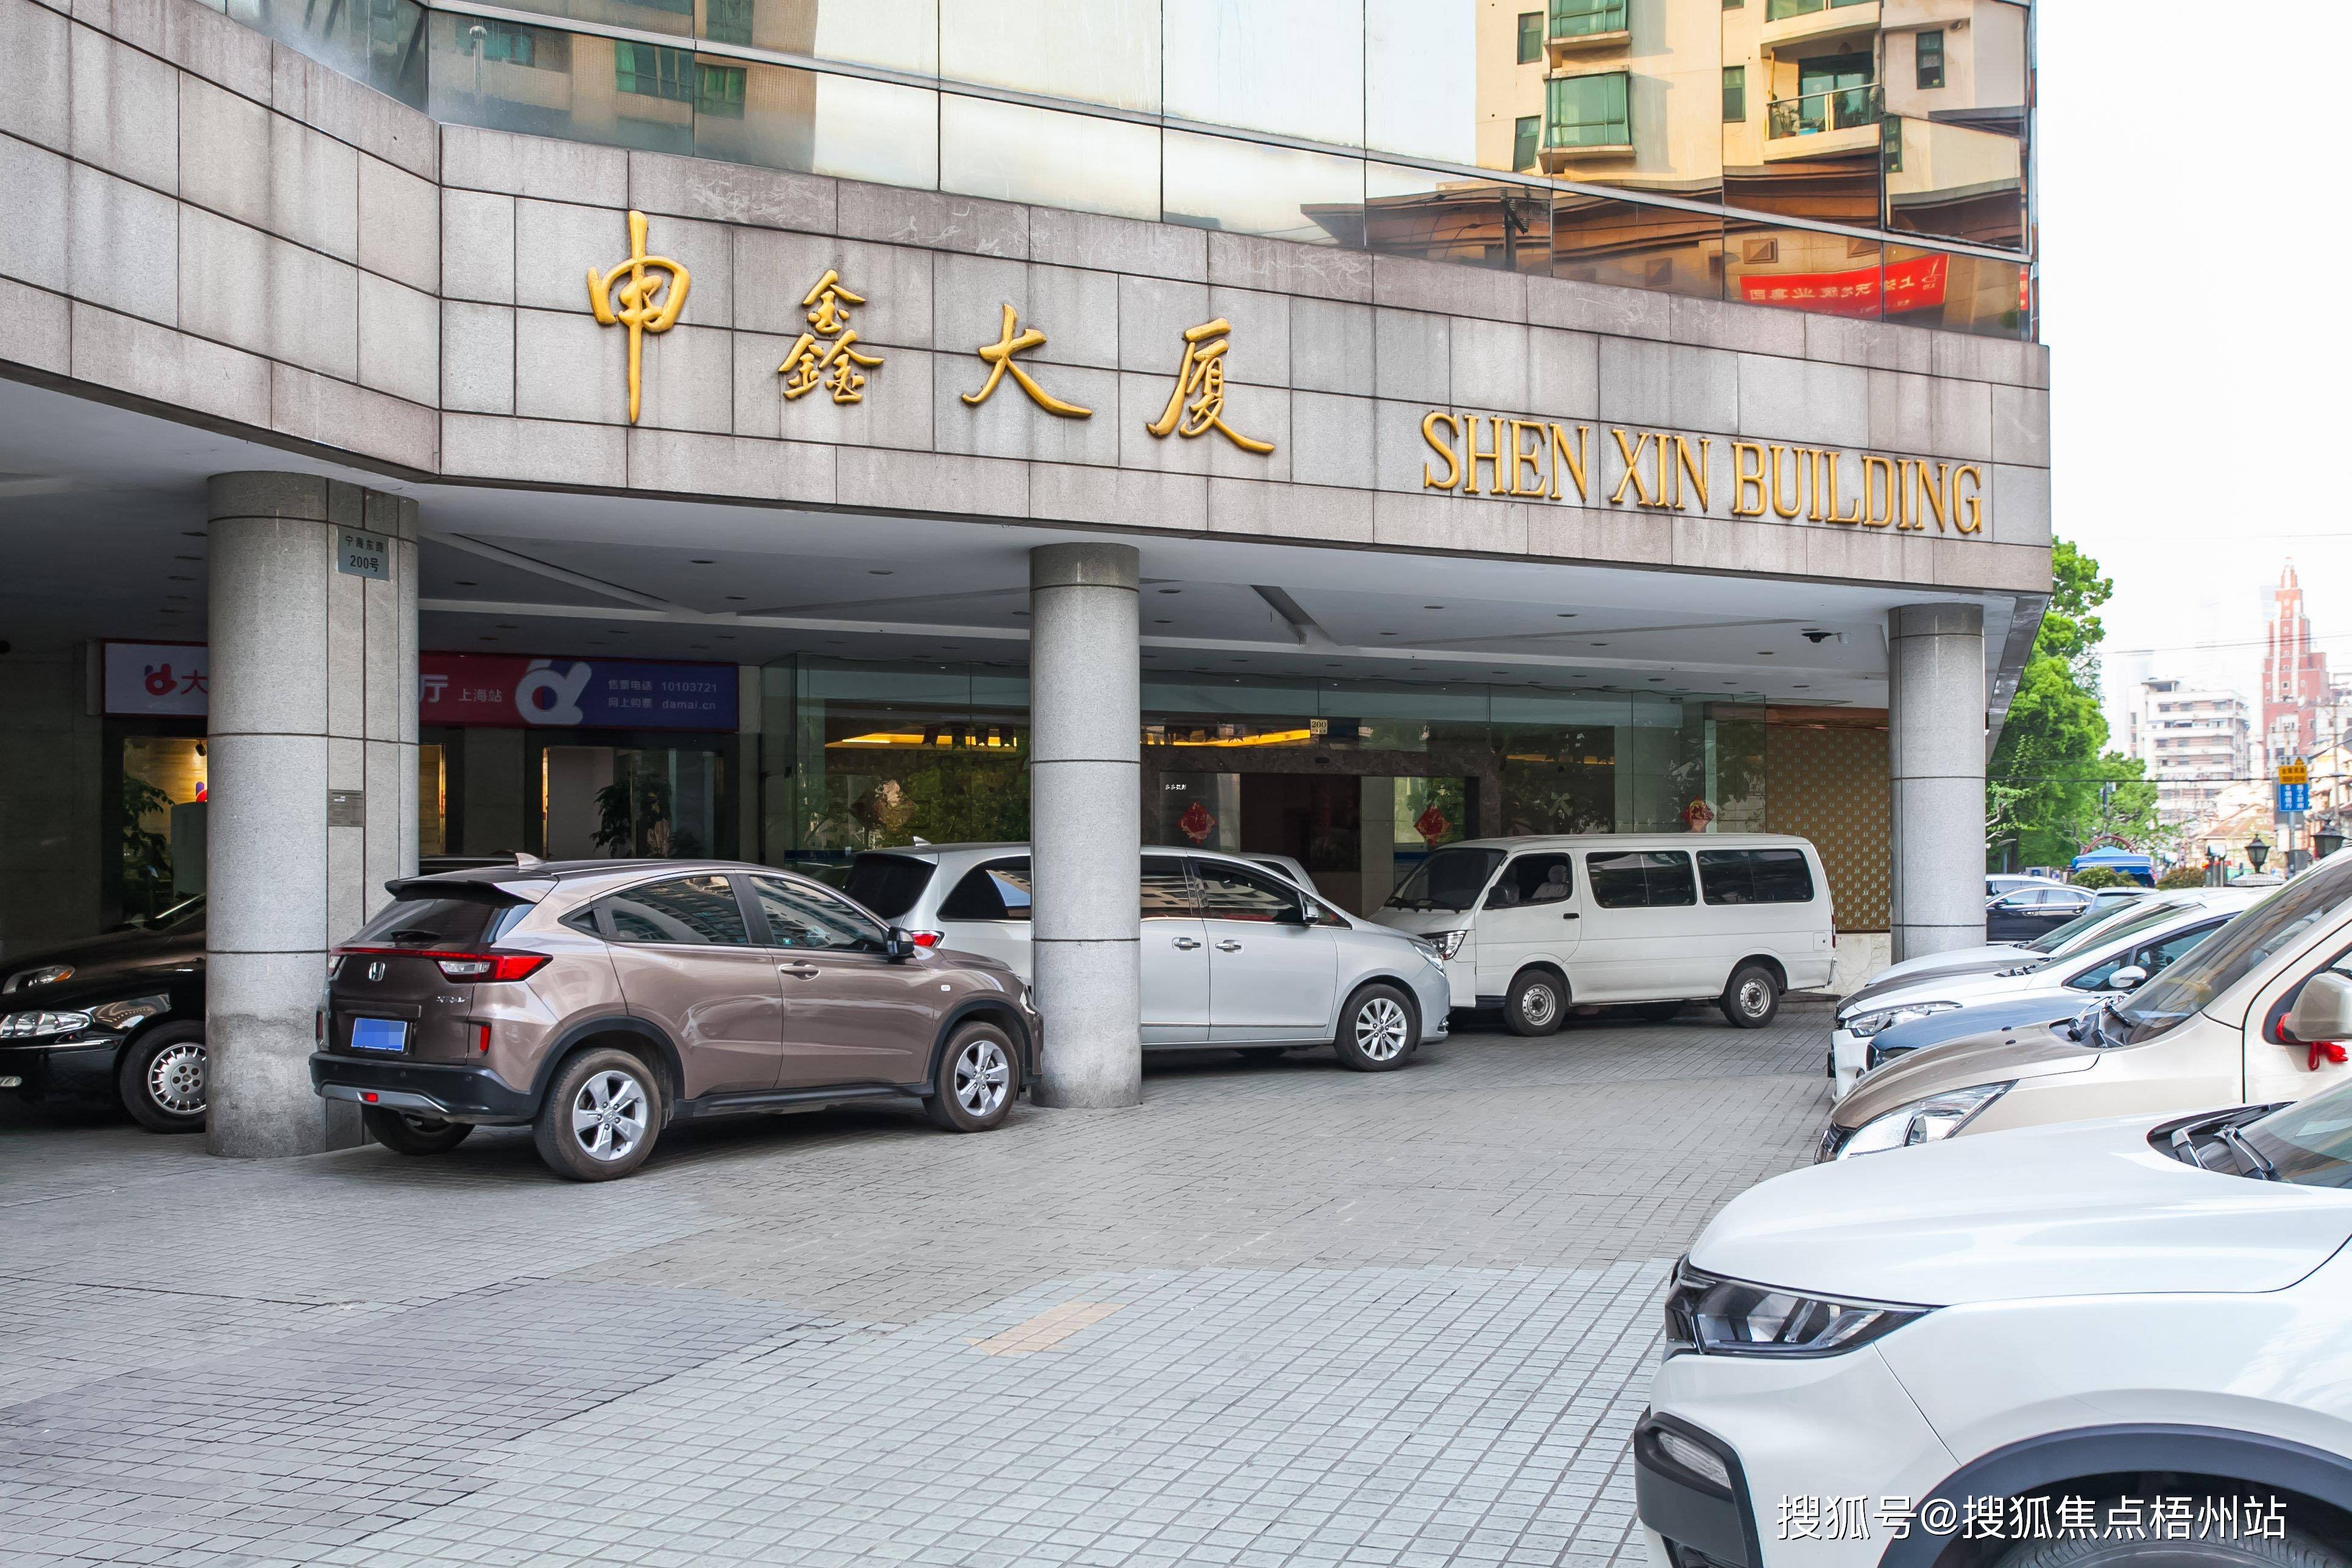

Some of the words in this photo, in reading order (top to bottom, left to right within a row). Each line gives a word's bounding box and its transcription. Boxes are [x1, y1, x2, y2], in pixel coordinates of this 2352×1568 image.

[587, 210, 1275, 454] 申鑫大厦
[1422, 411, 1589, 502] SHEN
[1611, 428, 1711, 512] XIN
[1732, 441, 1983, 534] BUILDING
[345, 535, 384, 553] 宁海东路
[350, 554, 380, 572] 200号
[458, 688, 502, 702] 上海站
[608, 679, 652, 691] 售票电话
[662, 682, 717, 693] 10103721
[608, 697, 652, 708] 网上购票
[662, 699, 716, 710] damai.cn
